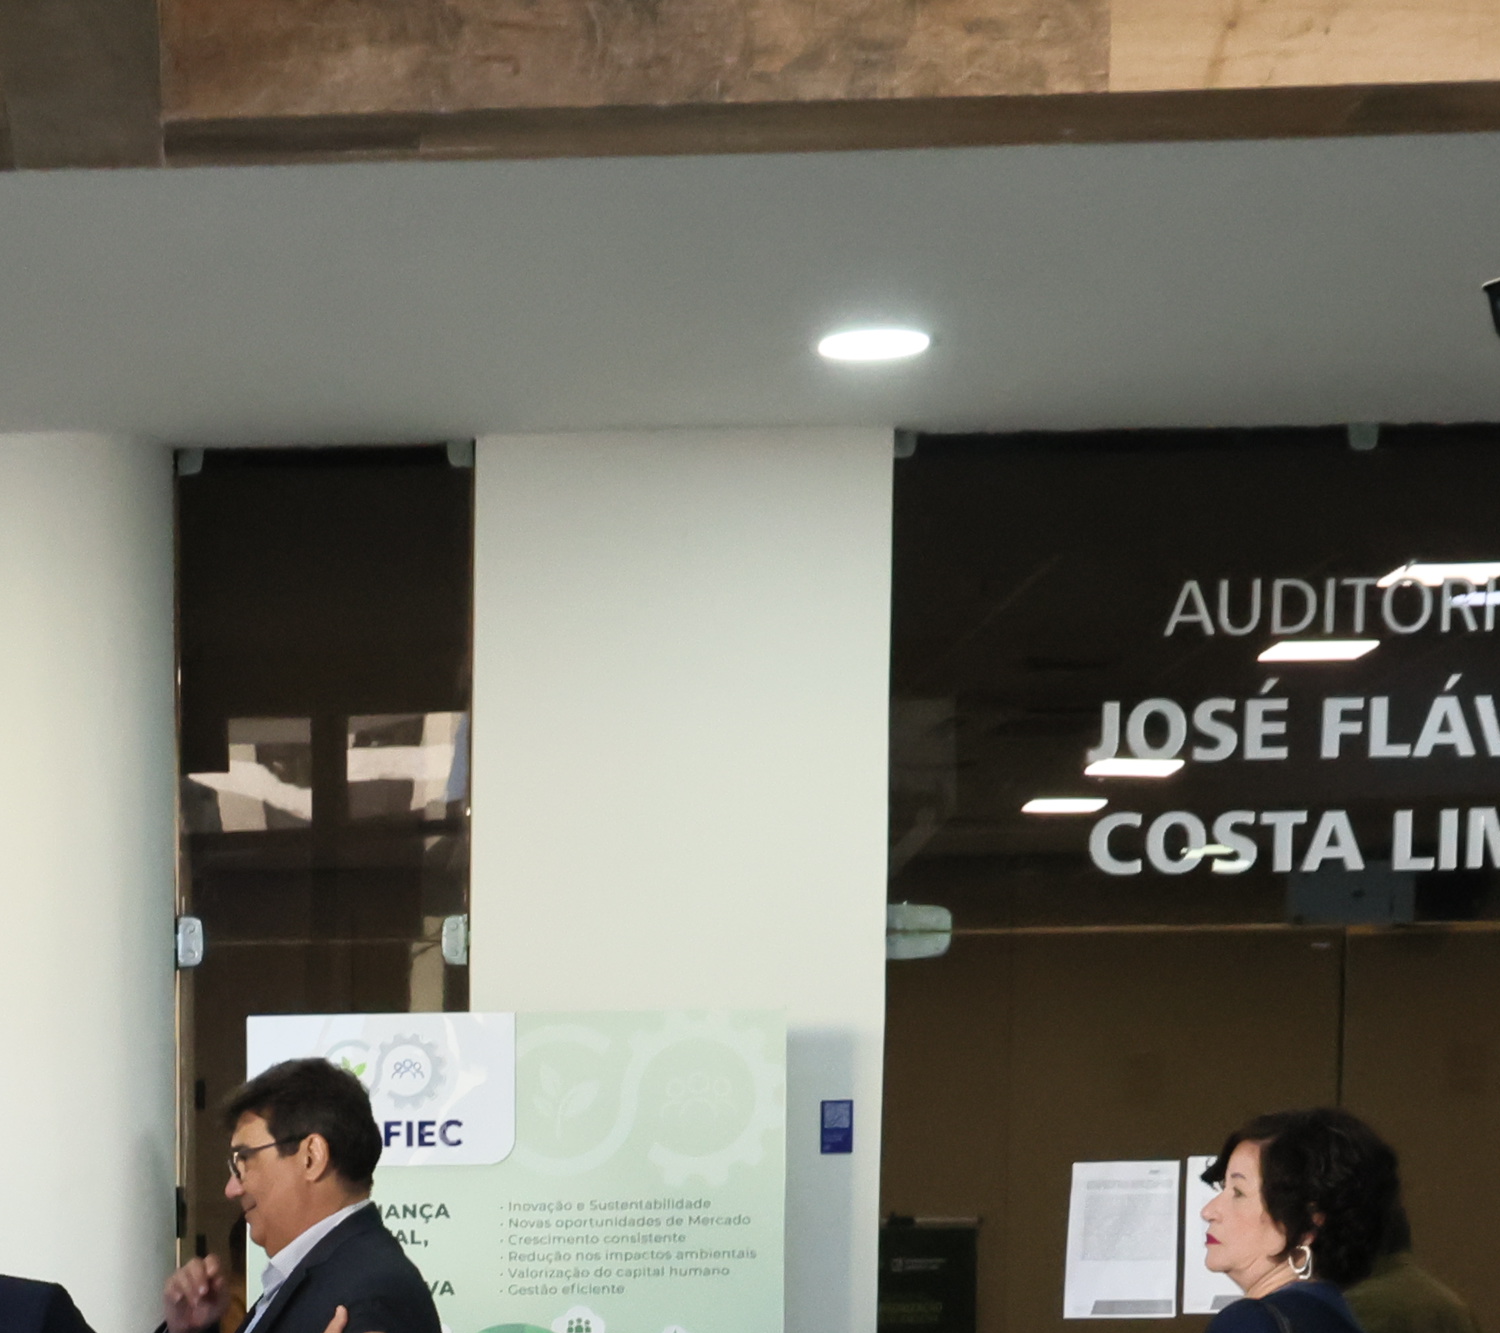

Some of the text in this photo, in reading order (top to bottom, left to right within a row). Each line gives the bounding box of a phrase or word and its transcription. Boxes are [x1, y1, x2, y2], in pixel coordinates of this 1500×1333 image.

[1085, 676, 1289, 764] JOSÉ
[1088, 809, 1365, 876] COSTA
[508, 1198, 712, 1213] Inovação e Sustentabilidade
[508, 1214, 751, 1231] Novas oportunidades de Mercado
[508, 1232, 687, 1246] Crescimento consistente
[508, 1250, 572, 1265] Redução
[604, 1249, 673, 1263] impactos
[675, 1248, 758, 1260] ambientais
[508, 1266, 590, 1280] Valorização
[615, 1265, 666, 1280] capital
[669, 1265, 730, 1277] humano
[508, 1283, 625, 1296] Gestão eficiente
